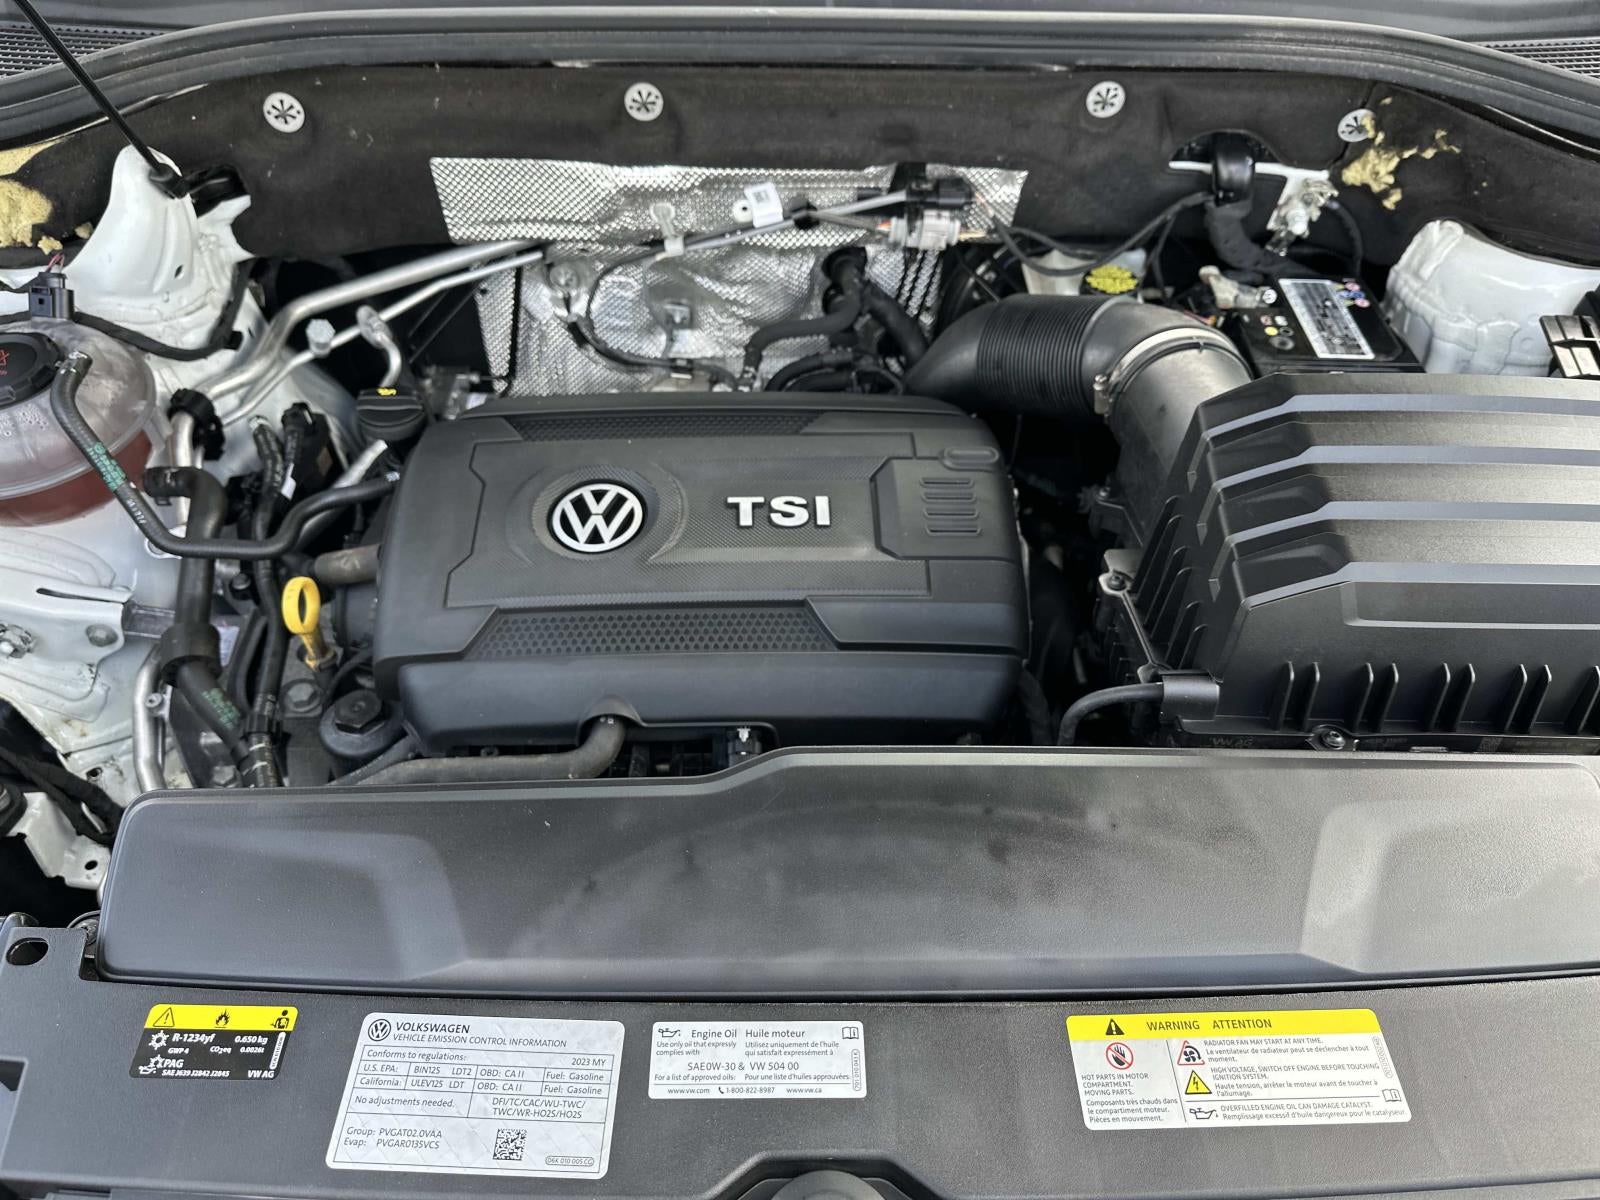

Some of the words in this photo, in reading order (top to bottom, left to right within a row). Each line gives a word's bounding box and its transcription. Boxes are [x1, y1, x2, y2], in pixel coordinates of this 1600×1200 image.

[727, 495, 831, 527] TSI
[396, 1021, 470, 1034] VOLKSWAGEN
[1146, 1020, 1200, 1031] WARNING
[1212, 1018, 1273, 1030] ATTENTION
[691, 1029, 722, 1040] Engine
[724, 1029, 737, 1038] Oil
[745, 1029, 770, 1038] Huile
[771, 1029, 805, 1038] moteur
[172, 1033, 216, 1044] R-1234yf
[234, 1035, 257, 1043] 0.650
[257, 1035, 268, 1045] kg
[393, 1033, 426, 1042] VEHICLE
[428, 1034, 467, 1044] EMISSION
[469, 1036, 507, 1045] CONTROL
[509, 1038, 567, 1048] INFORMATION
[669, 1041, 683, 1049] only
[693, 1040, 706, 1048] that
[707, 1040, 737, 1049] expressly
[770, 1041, 809, 1049] uniquement
[367, 1049, 406, 1058] Conforms
[408, 1051, 417, 1059] to
[418, 1052, 467, 1062] regulations:
[656, 1049, 684, 1057] complies
[744, 1049, 756, 1057] qui
[163, 1059, 184, 1068] PAG
[571, 1057, 591, 1066] 2023
[592, 1058, 607, 1067] MY
[687, 1062, 736, 1071] SAE0W-30
[738, 1062, 745, 1071] &
[750, 1062, 766, 1071] VW
[768, 1062, 785, 1071] 504
[787, 1062, 799, 1071] 00
[248, 1070, 262, 1078] VW
[261, 1070, 275, 1078] AG
[363, 1064, 378, 1072] U.S.
[380, 1064, 398, 1073] EPA:
[414, 1066, 441, 1075] BIN125
[451, 1067, 472, 1076] LDT2
[479, 1068, 501, 1077] OBD:
[504, 1069, 516, 1078] CA
[546, 1071, 565, 1080] Fuel:
[569, 1072, 604, 1081] Gasoline
[691, 1074, 721, 1082] approved
[360, 1076, 401, 1086] California:
[411, 1079, 443, 1088] ULEV125
[449, 1080, 465, 1089] LDT
[477, 1082, 498, 1090] OBD:
[502, 1083, 514, 1091] CA
[544, 1084, 563, 1093] Fuel:
[567, 1085, 602, 1095] Gasoline
[1082, 1081, 1133, 1089] COMPARTMENT.
[354, 1096, 366, 1104] No
[368, 1096, 420, 1107] adjustments
[421, 1098, 455, 1108] needed.
[1086, 1099, 1126, 1107] Composants
[1095, 1107, 1143, 1115] compartiment
[347, 1127, 376, 1137] Group:
[343, 1137, 367, 1148] Evap:
